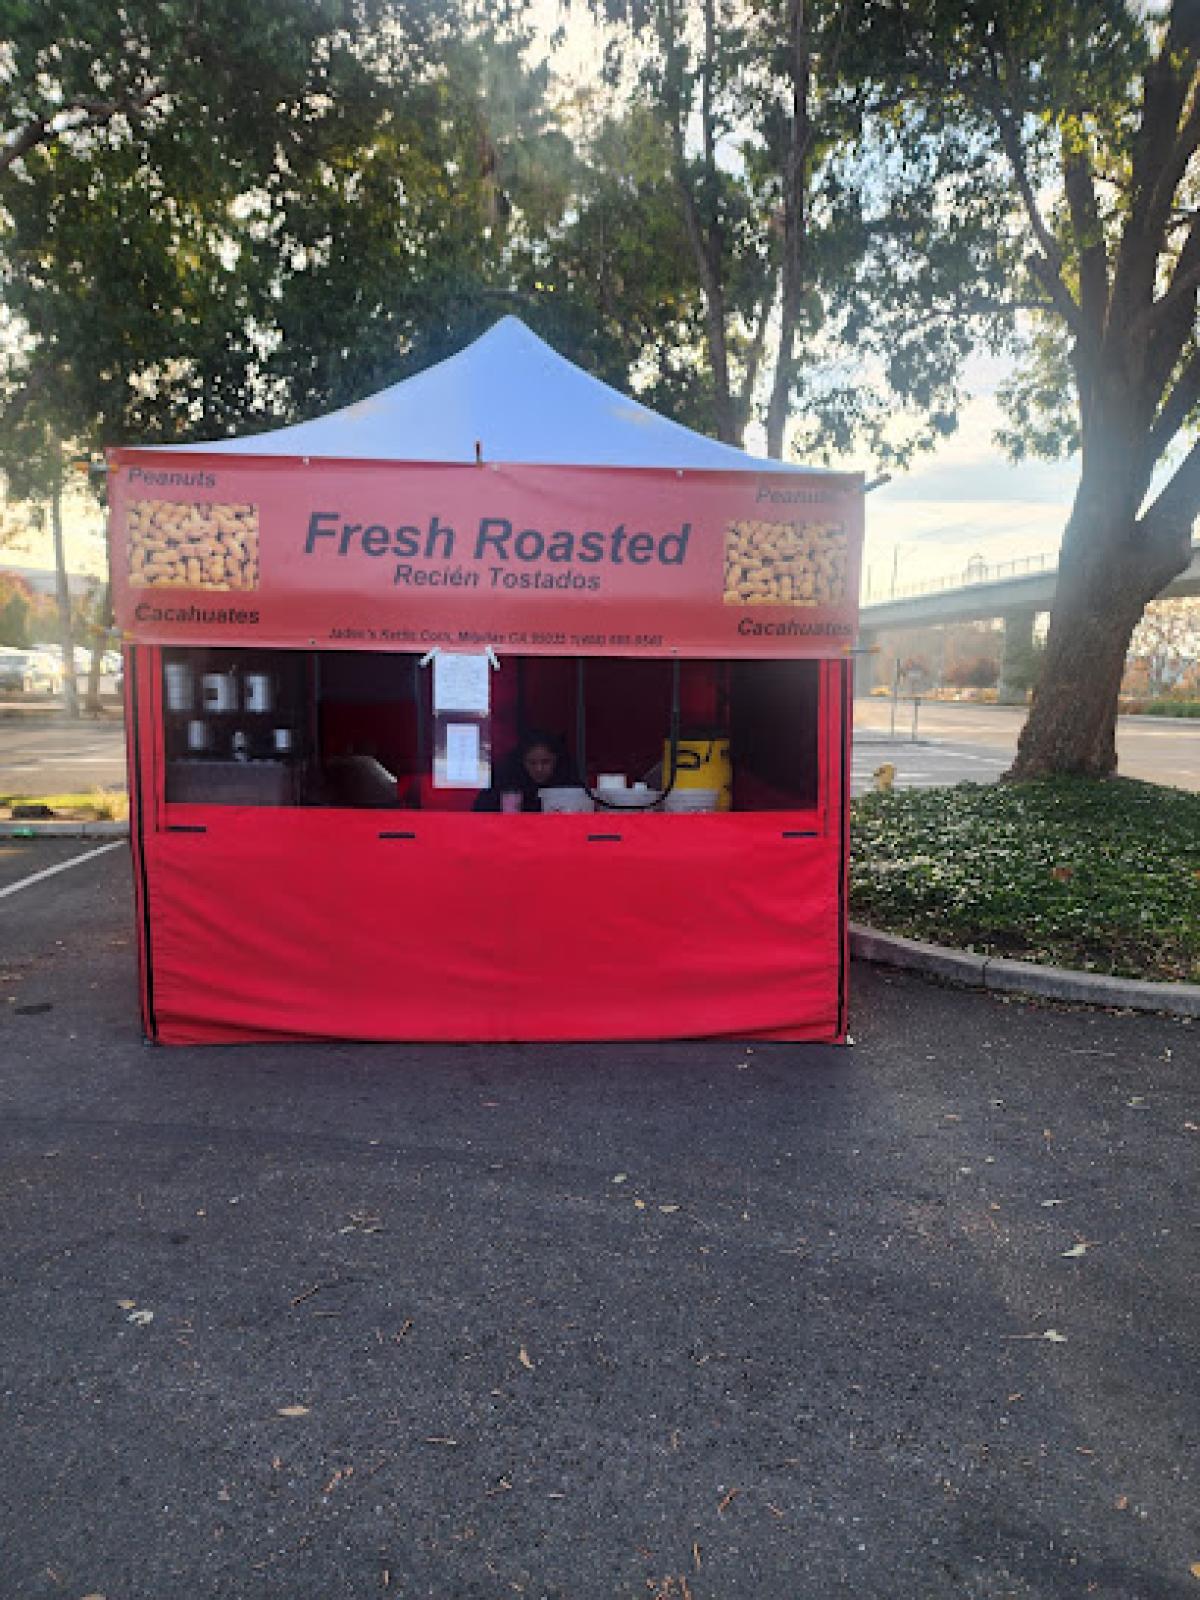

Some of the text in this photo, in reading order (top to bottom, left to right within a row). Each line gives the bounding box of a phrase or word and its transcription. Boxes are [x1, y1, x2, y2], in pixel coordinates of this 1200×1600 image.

[128, 466, 216, 487] Peanuts
[756, 485, 832, 503] Peanu
[303, 511, 692, 565] Fresh Roasted
[393, 563, 601, 590] Recién Tostados
[134, 602, 260, 624] Cacahuates
[737, 617, 854, 637] Cacahuates
